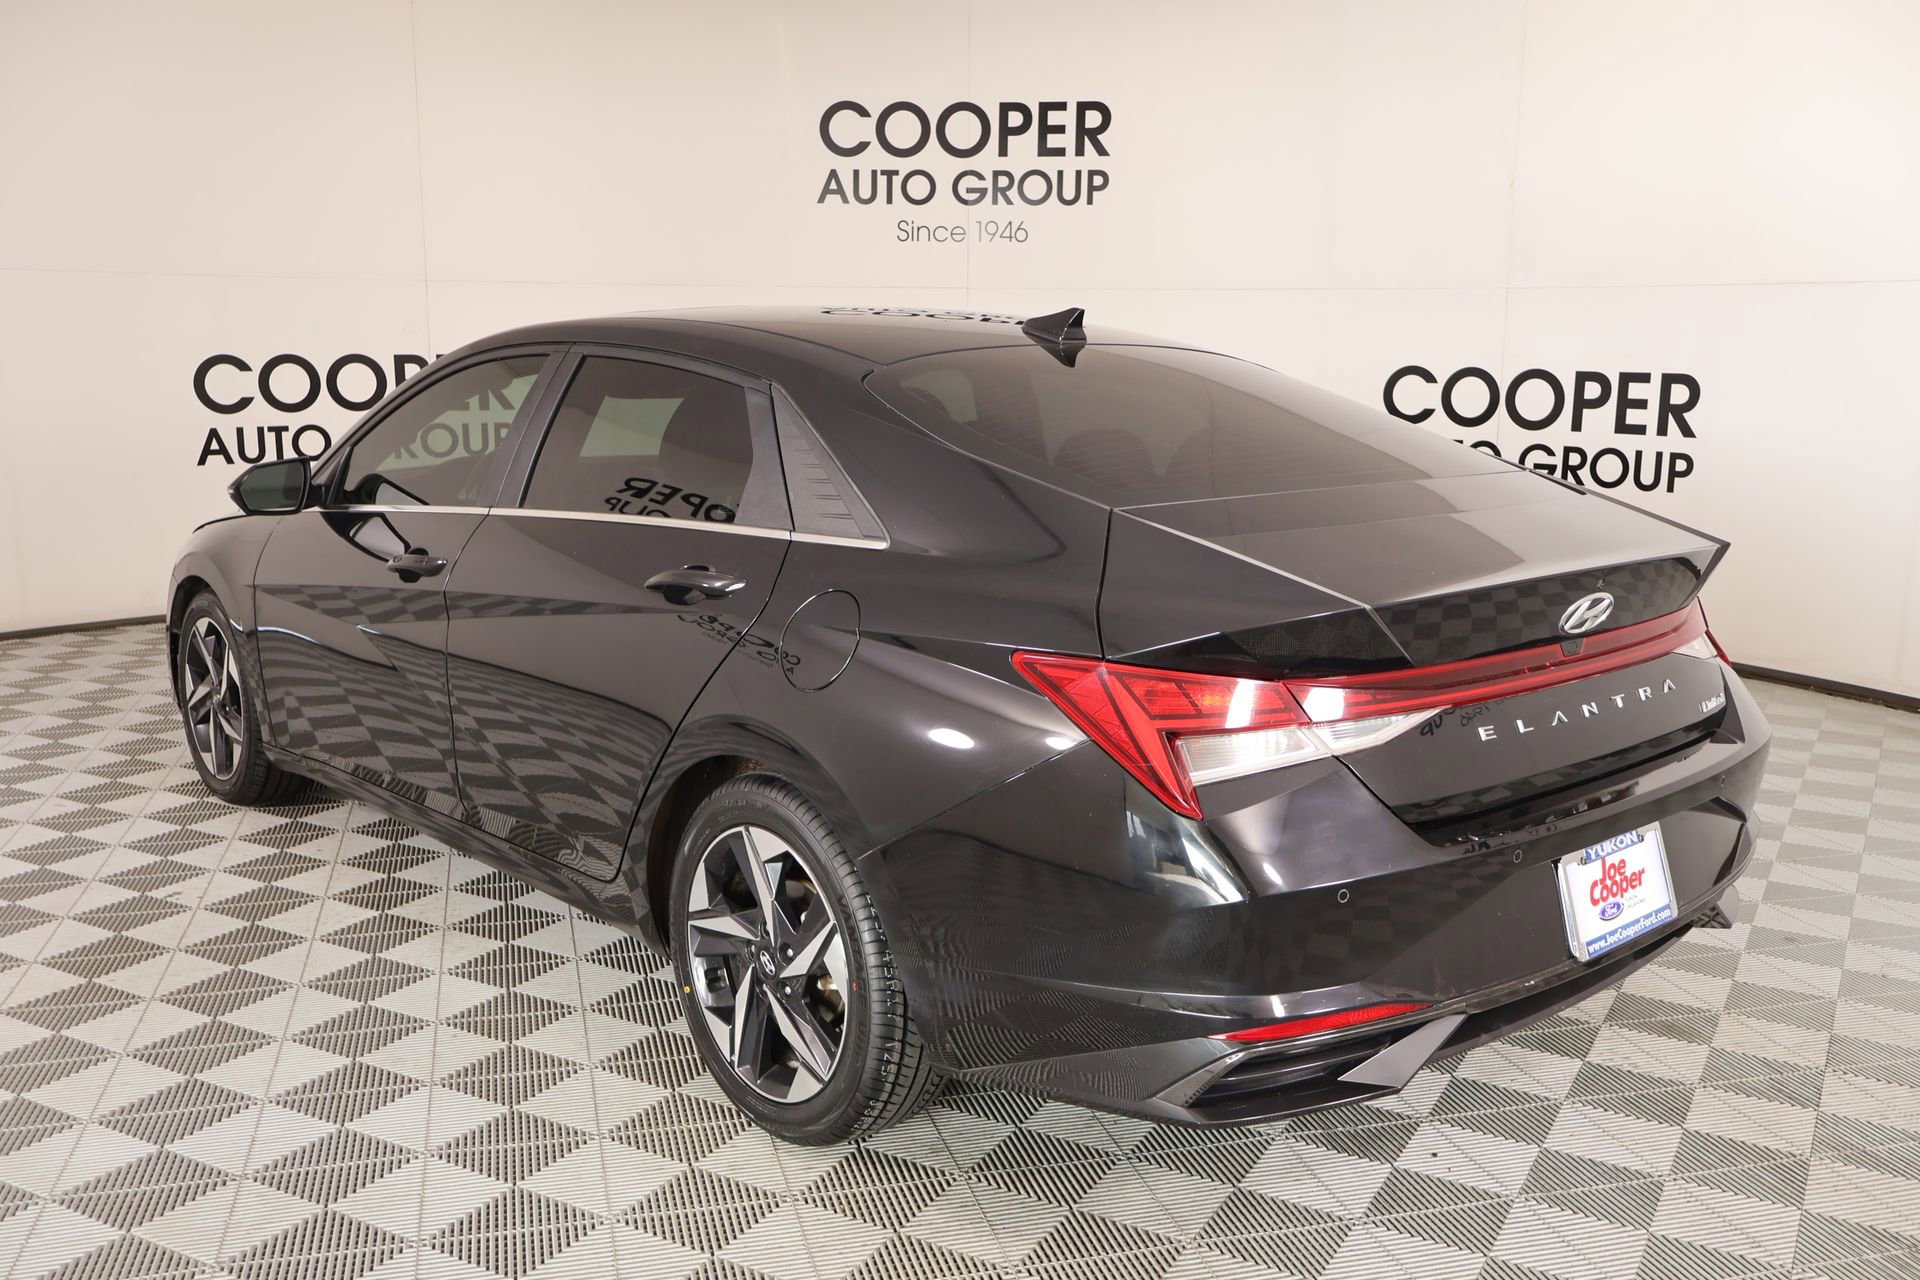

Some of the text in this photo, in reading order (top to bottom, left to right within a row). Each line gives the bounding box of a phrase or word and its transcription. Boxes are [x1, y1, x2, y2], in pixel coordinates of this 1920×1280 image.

[819, 100, 1112, 158] COOPER
[817, 168, 1110, 206] AUTO GROUP
[896, 219, 1029, 243] Since 1946
[193, 353, 516, 414] COOP
[1383, 365, 1701, 438] COOPER
[197, 424, 332, 466] AUTO
[1518, 443, 1694, 493] GROUP
[1477, 679, 1677, 741] ELANTRA
[1586, 830, 1640, 860] YUKON
[1590, 868, 1645, 906] Cooper
[1599, 856, 1626, 884] Joe
[1587, 908, 1671, 953] www.JoeCooperFord.com
